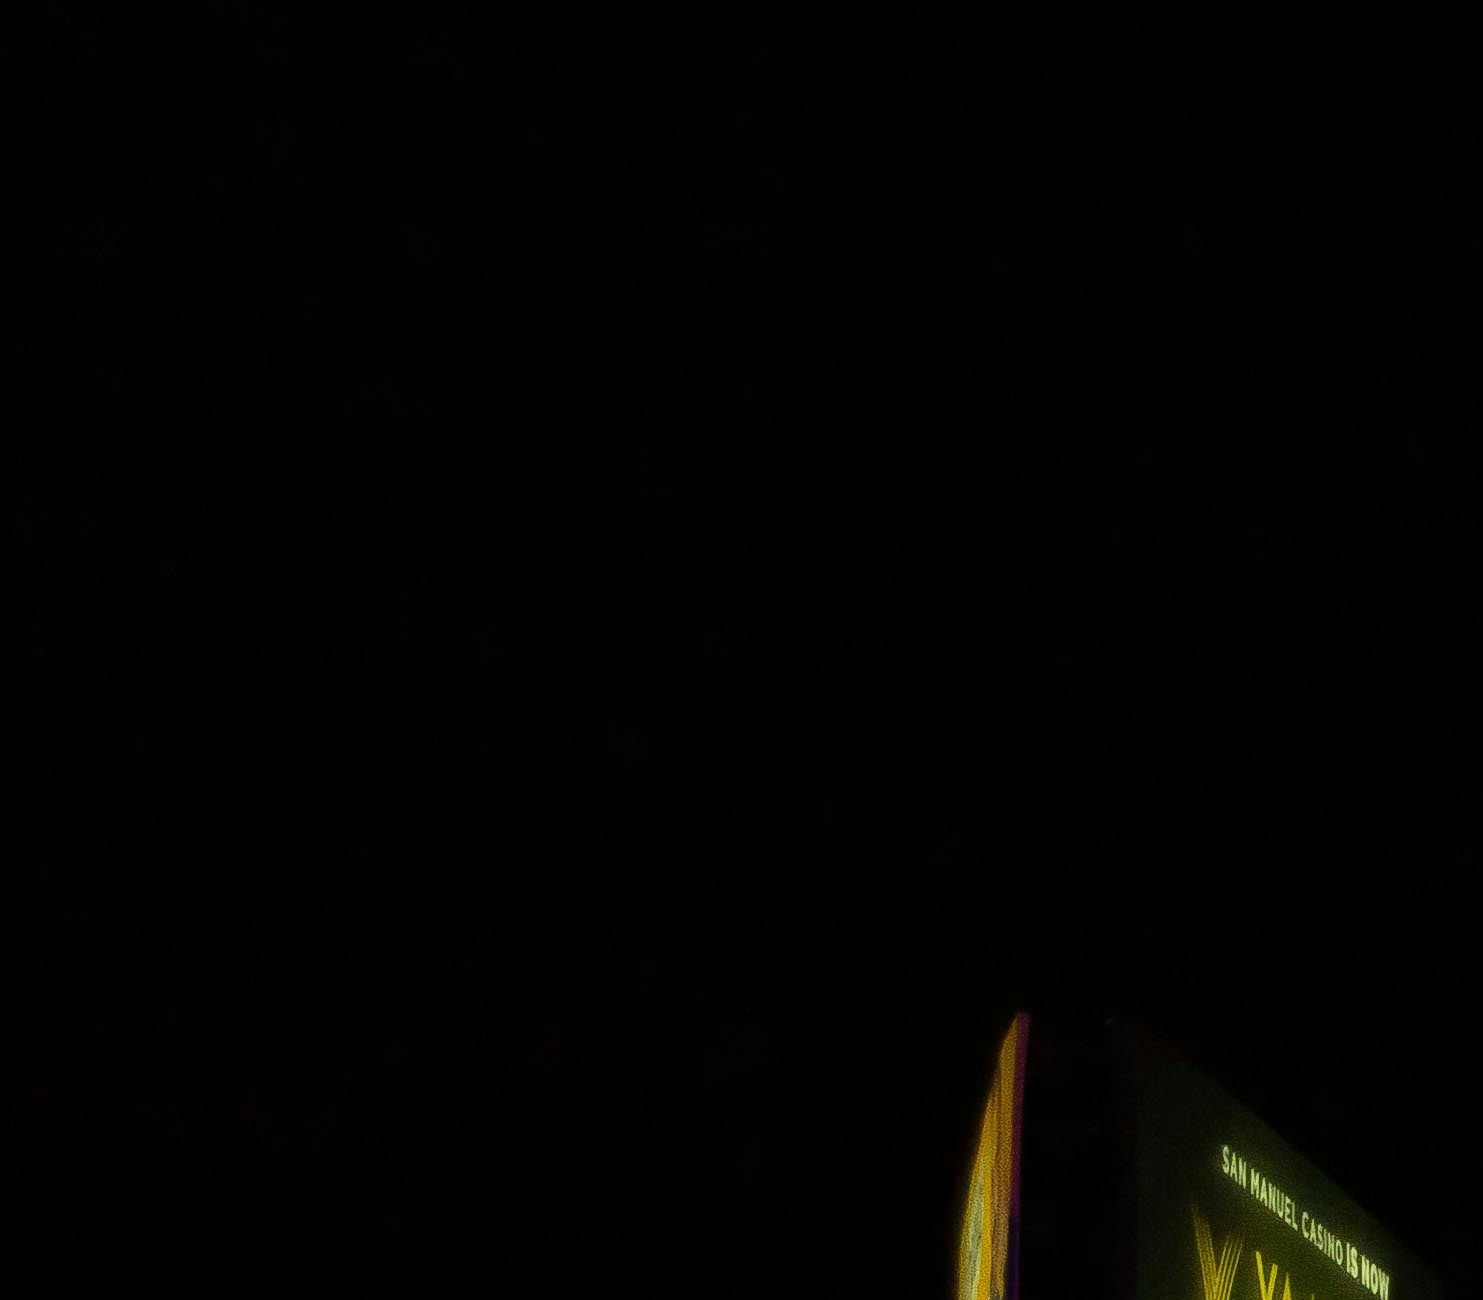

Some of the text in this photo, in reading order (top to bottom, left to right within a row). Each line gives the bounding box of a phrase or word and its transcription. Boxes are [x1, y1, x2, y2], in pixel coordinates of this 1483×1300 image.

[1221, 1144, 1247, 1189] SAN
[1250, 1168, 1298, 1231] MANUEL
[1302, 1211, 1344, 1265] CASINO
[1346, 1243, 1359, 1278] IS
